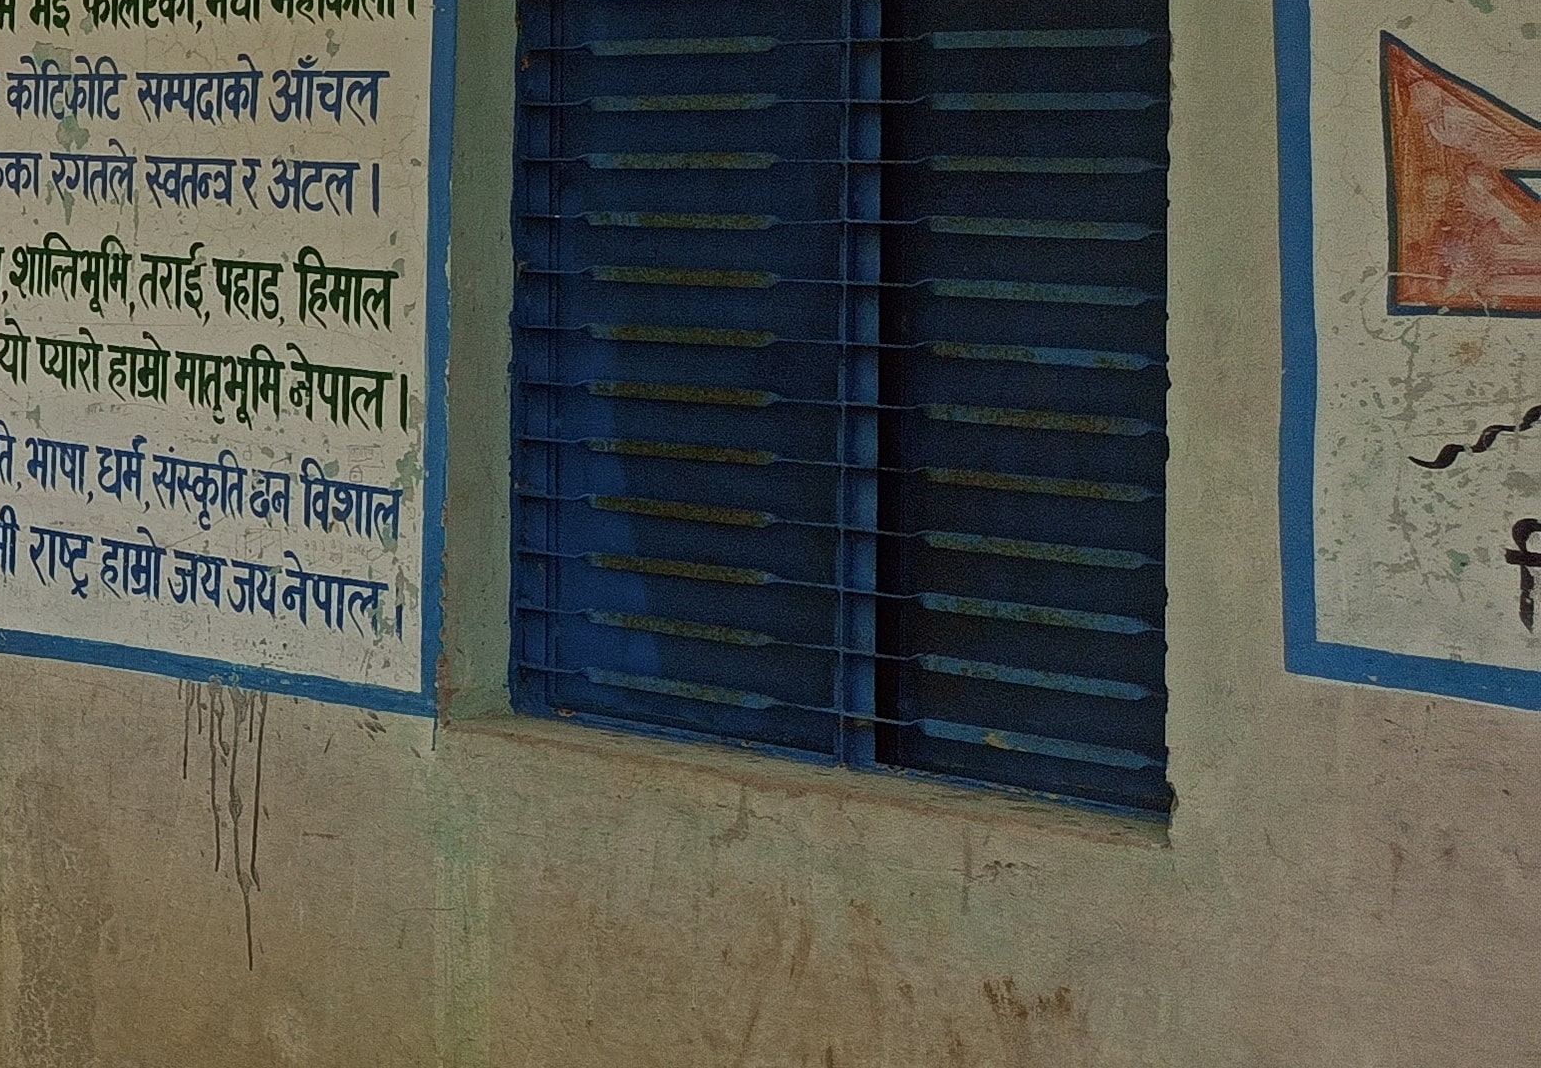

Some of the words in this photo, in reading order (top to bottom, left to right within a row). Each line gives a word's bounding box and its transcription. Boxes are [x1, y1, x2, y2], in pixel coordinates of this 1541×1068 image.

[135, 52, 264, 128] सम्पदाको
[267, 54, 391, 128] आँचल
[49, 137, 139, 208] रगतले
[144, 153, 238, 211] स्वतन्त्र
[241, 157, 263, 212] र
[267, 157, 362, 218] अटल
[292, 244, 401, 334] हिमाल
[35, 326, 105, 395] प्यारो
[107, 330, 172, 405] हाम्रो
[174, 342, 287, 432] मातृभूमि
[285, 341, 395, 433] नेपाल
[151, 445, 249, 532] संस्कृति
[298, 456, 404, 549] विशाल
[29, 525, 96, 601] राष्ट्र
[99, 525, 168, 605] हाम्रो
[166, 548, 229, 613] जय
[226, 558, 283, 622] जय
[281, 549, 390, 640] नेपाल
